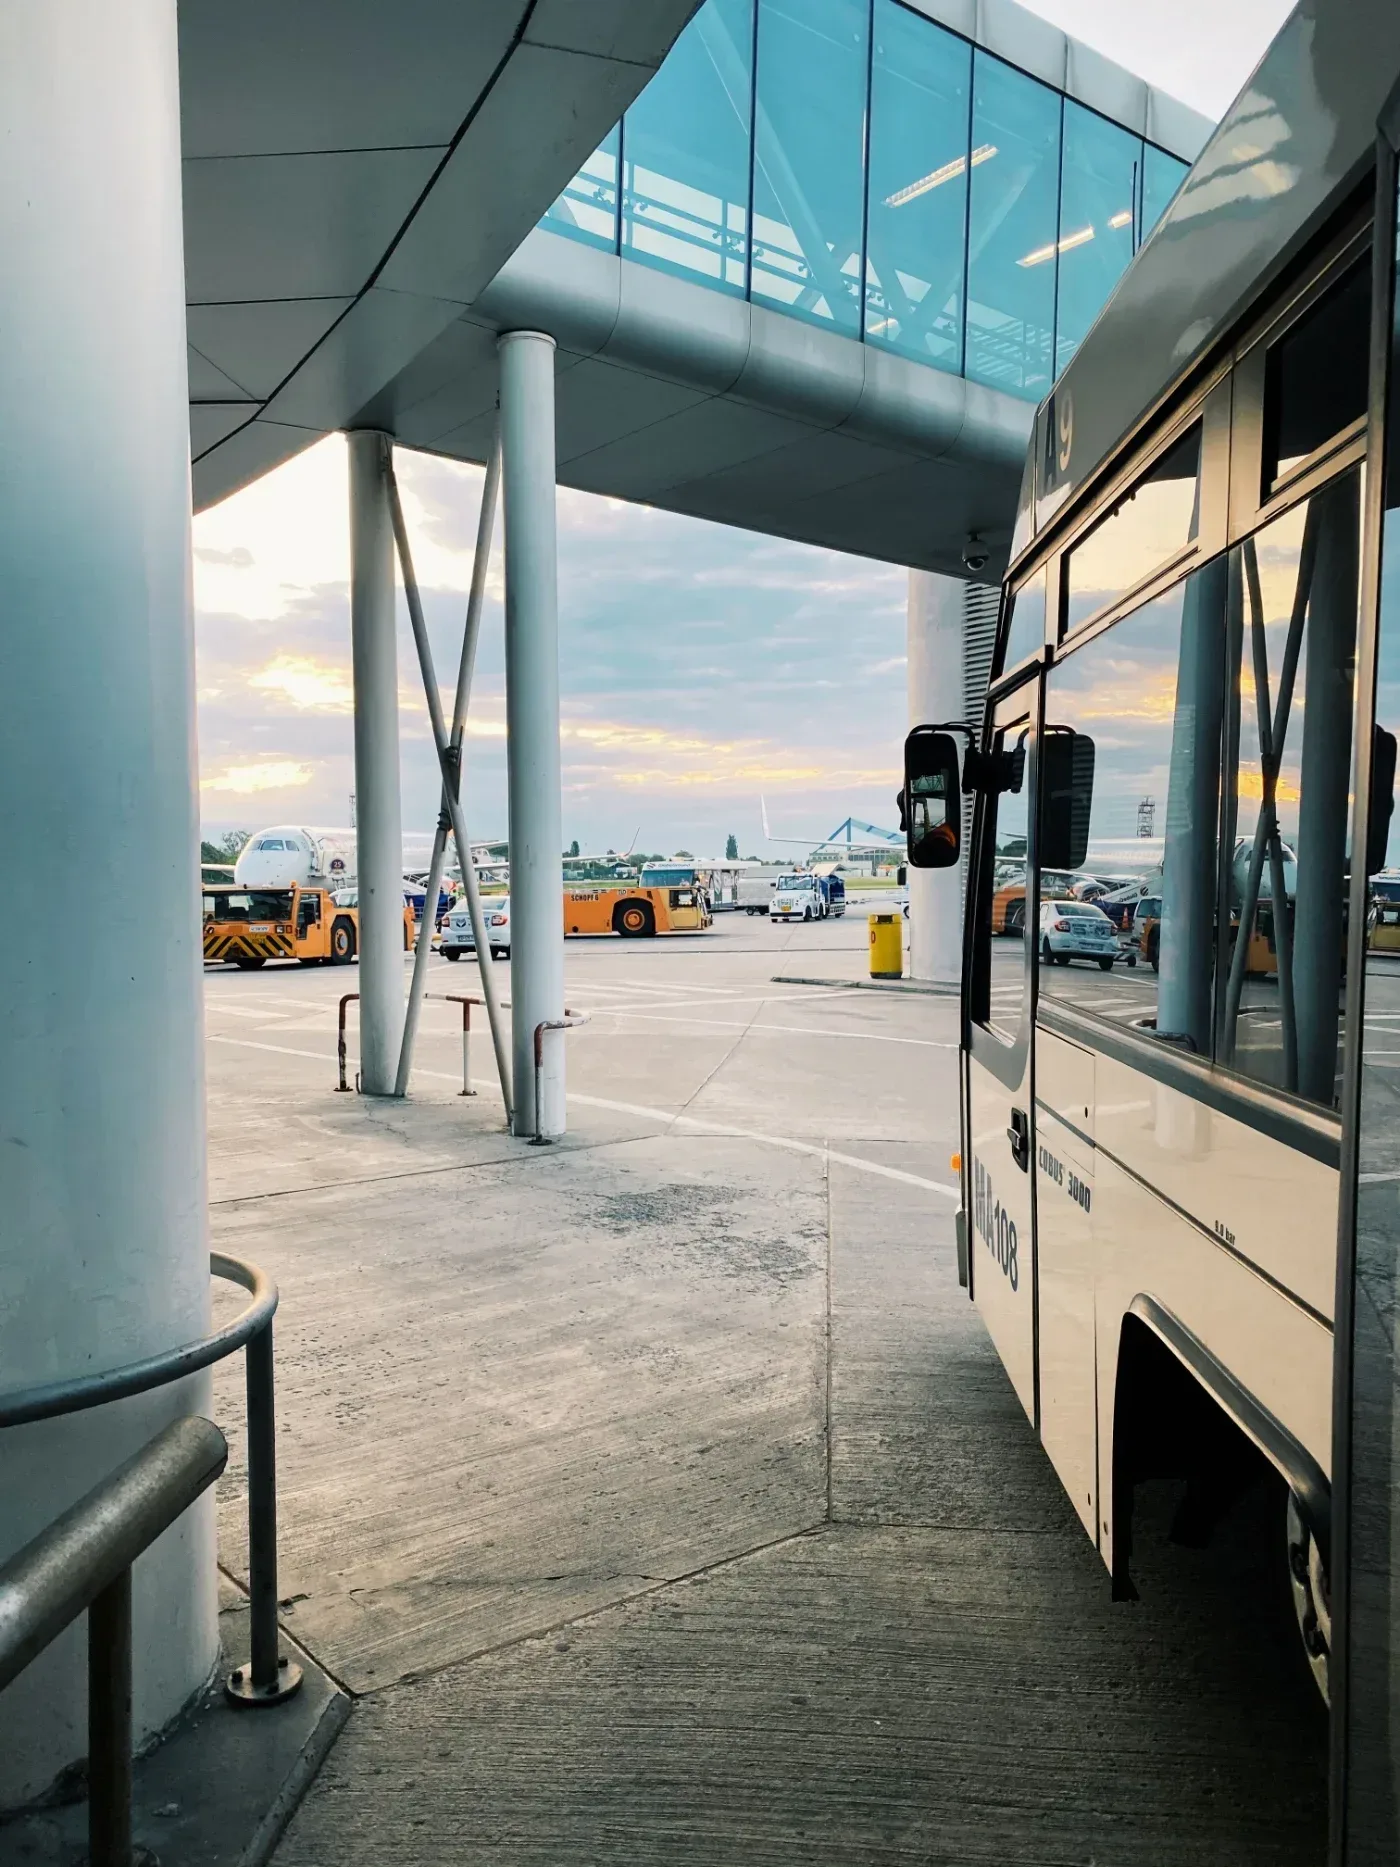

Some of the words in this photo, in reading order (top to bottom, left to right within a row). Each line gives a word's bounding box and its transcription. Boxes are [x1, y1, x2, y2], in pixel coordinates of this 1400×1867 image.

[1039, 1145, 1063, 1187] COBUS
[1067, 1170, 1091, 1214] 3000
[1225, 1226, 1236, 1246] bar
